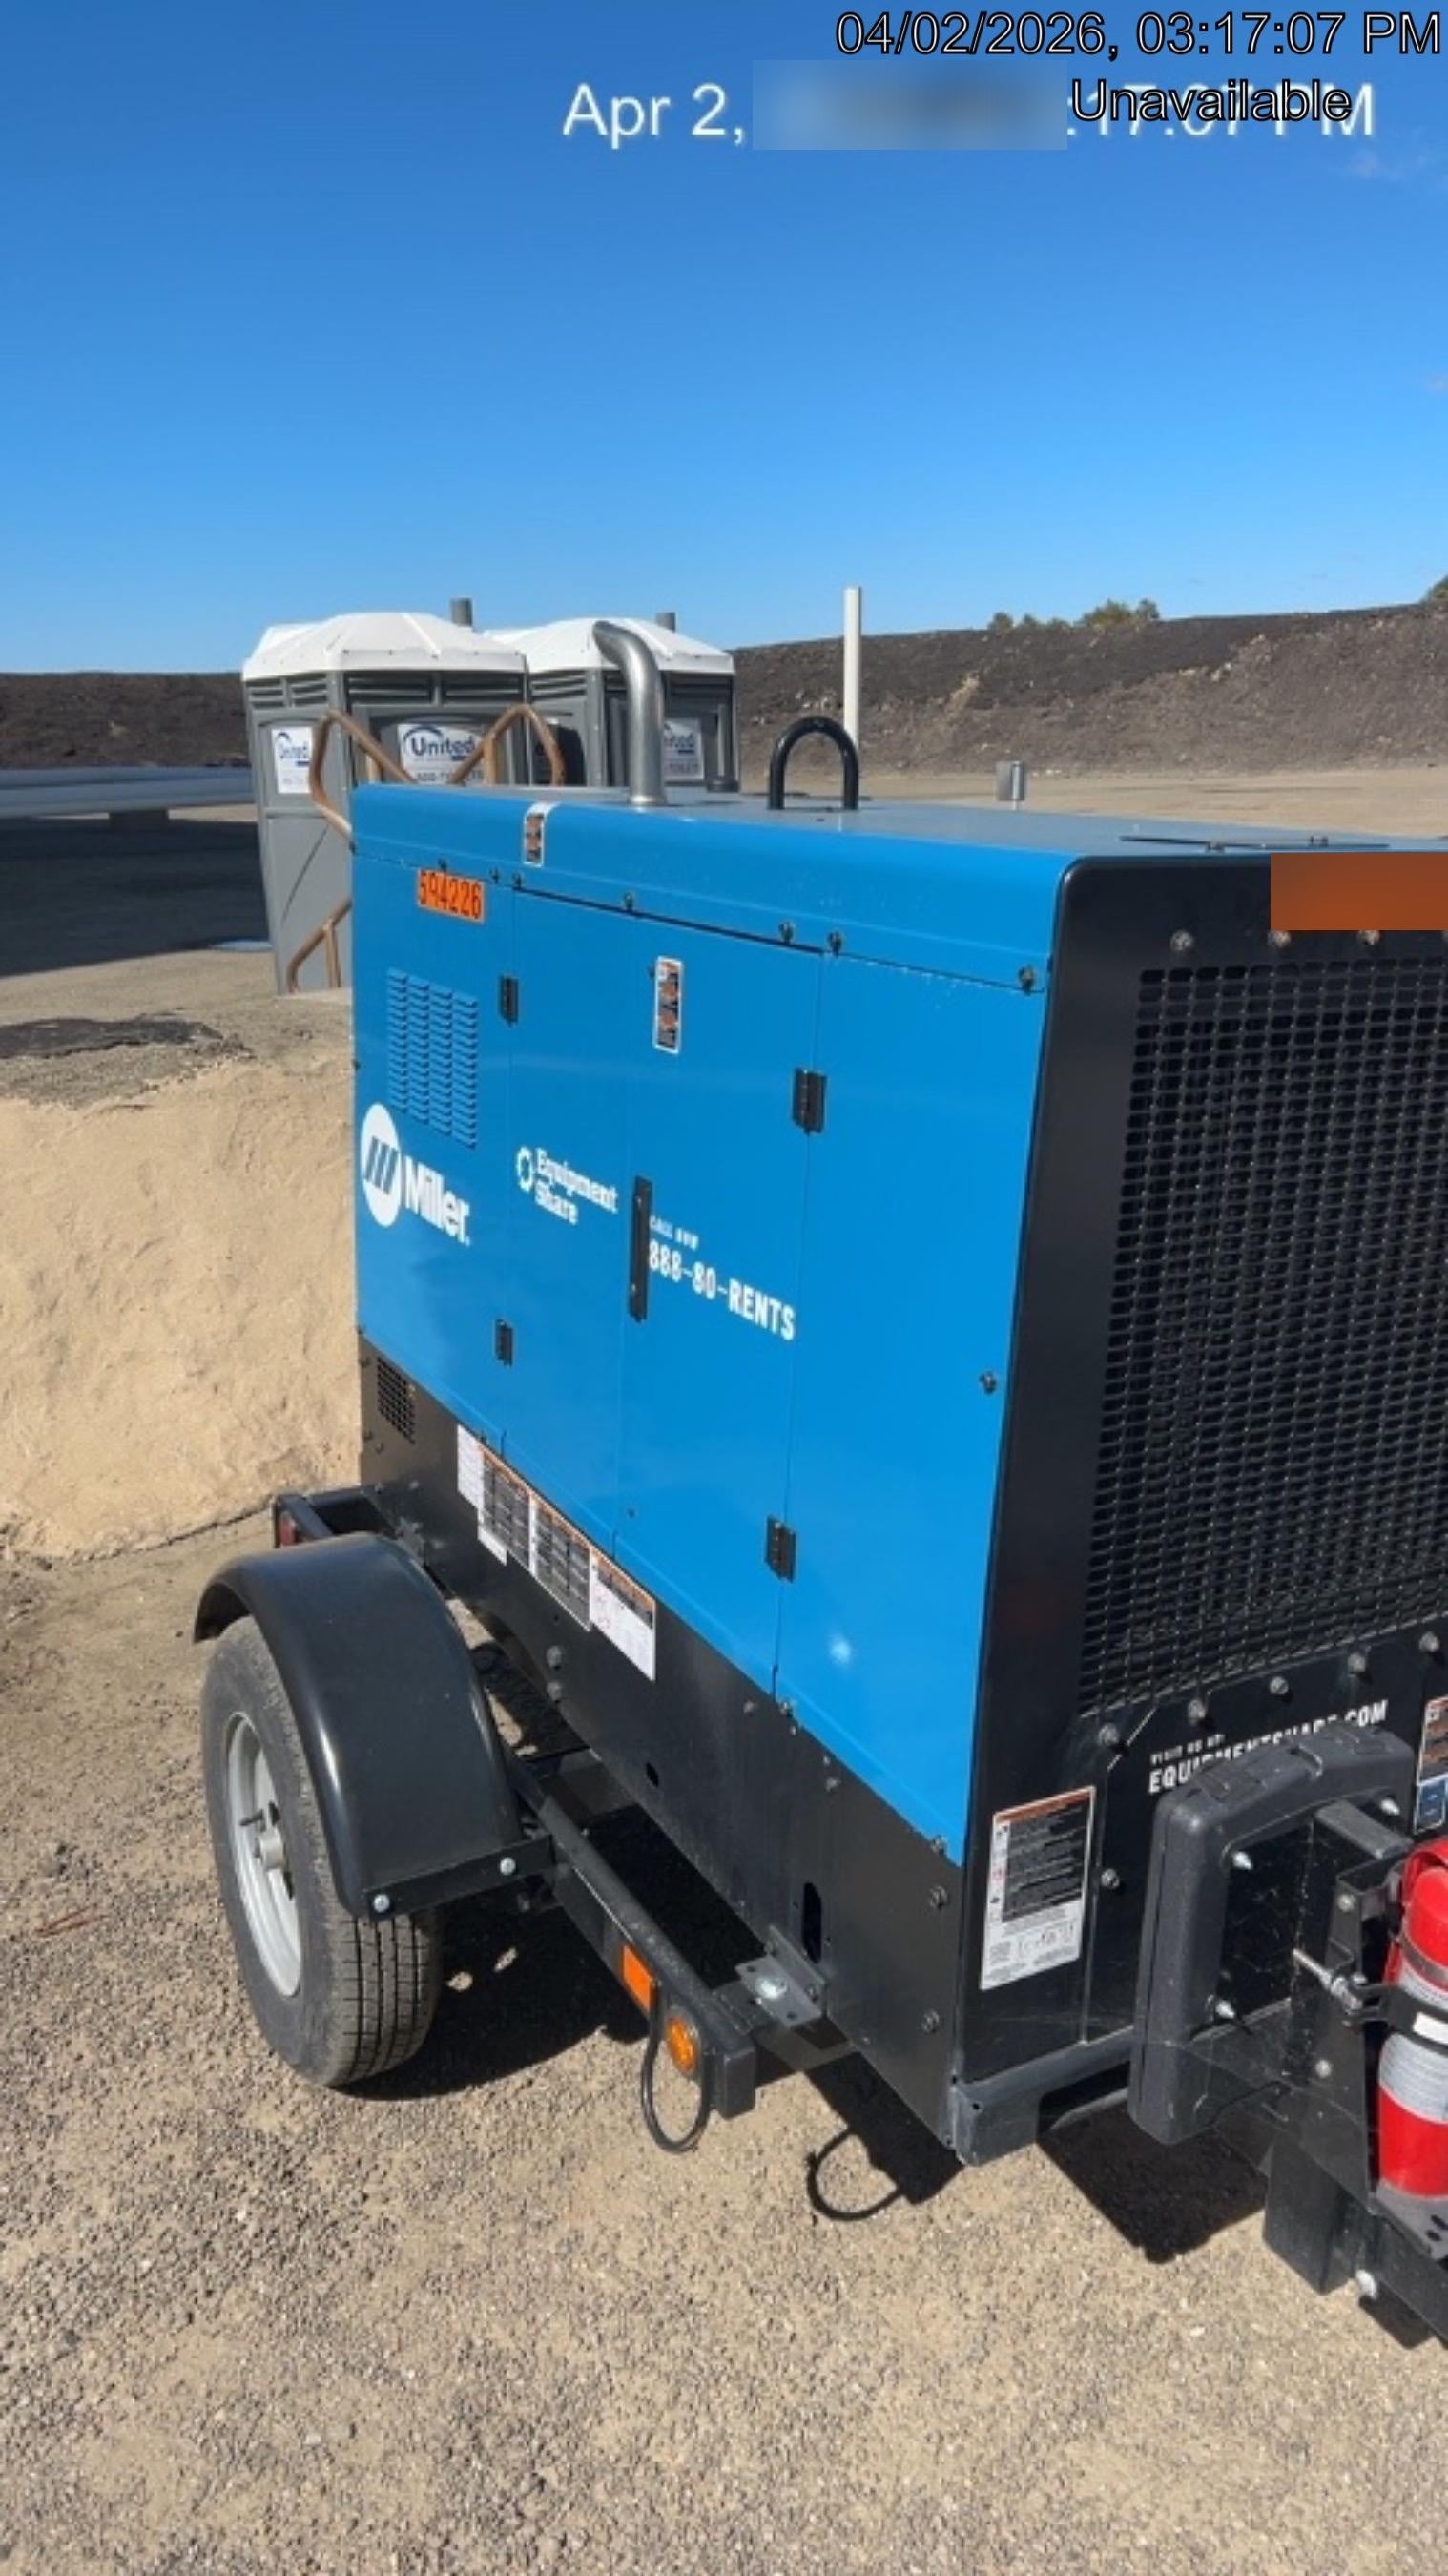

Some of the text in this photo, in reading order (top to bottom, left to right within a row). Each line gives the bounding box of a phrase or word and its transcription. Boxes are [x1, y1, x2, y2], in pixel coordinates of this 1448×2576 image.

[410, 736, 476, 757] United
[420, 869, 483, 920] 594226
[404, 1155, 469, 1244] Miller
[535, 1179, 578, 1225] Share
[536, 1147, 618, 1214] Equipment
[649, 1238, 796, 1340] 888-80-RENTS
